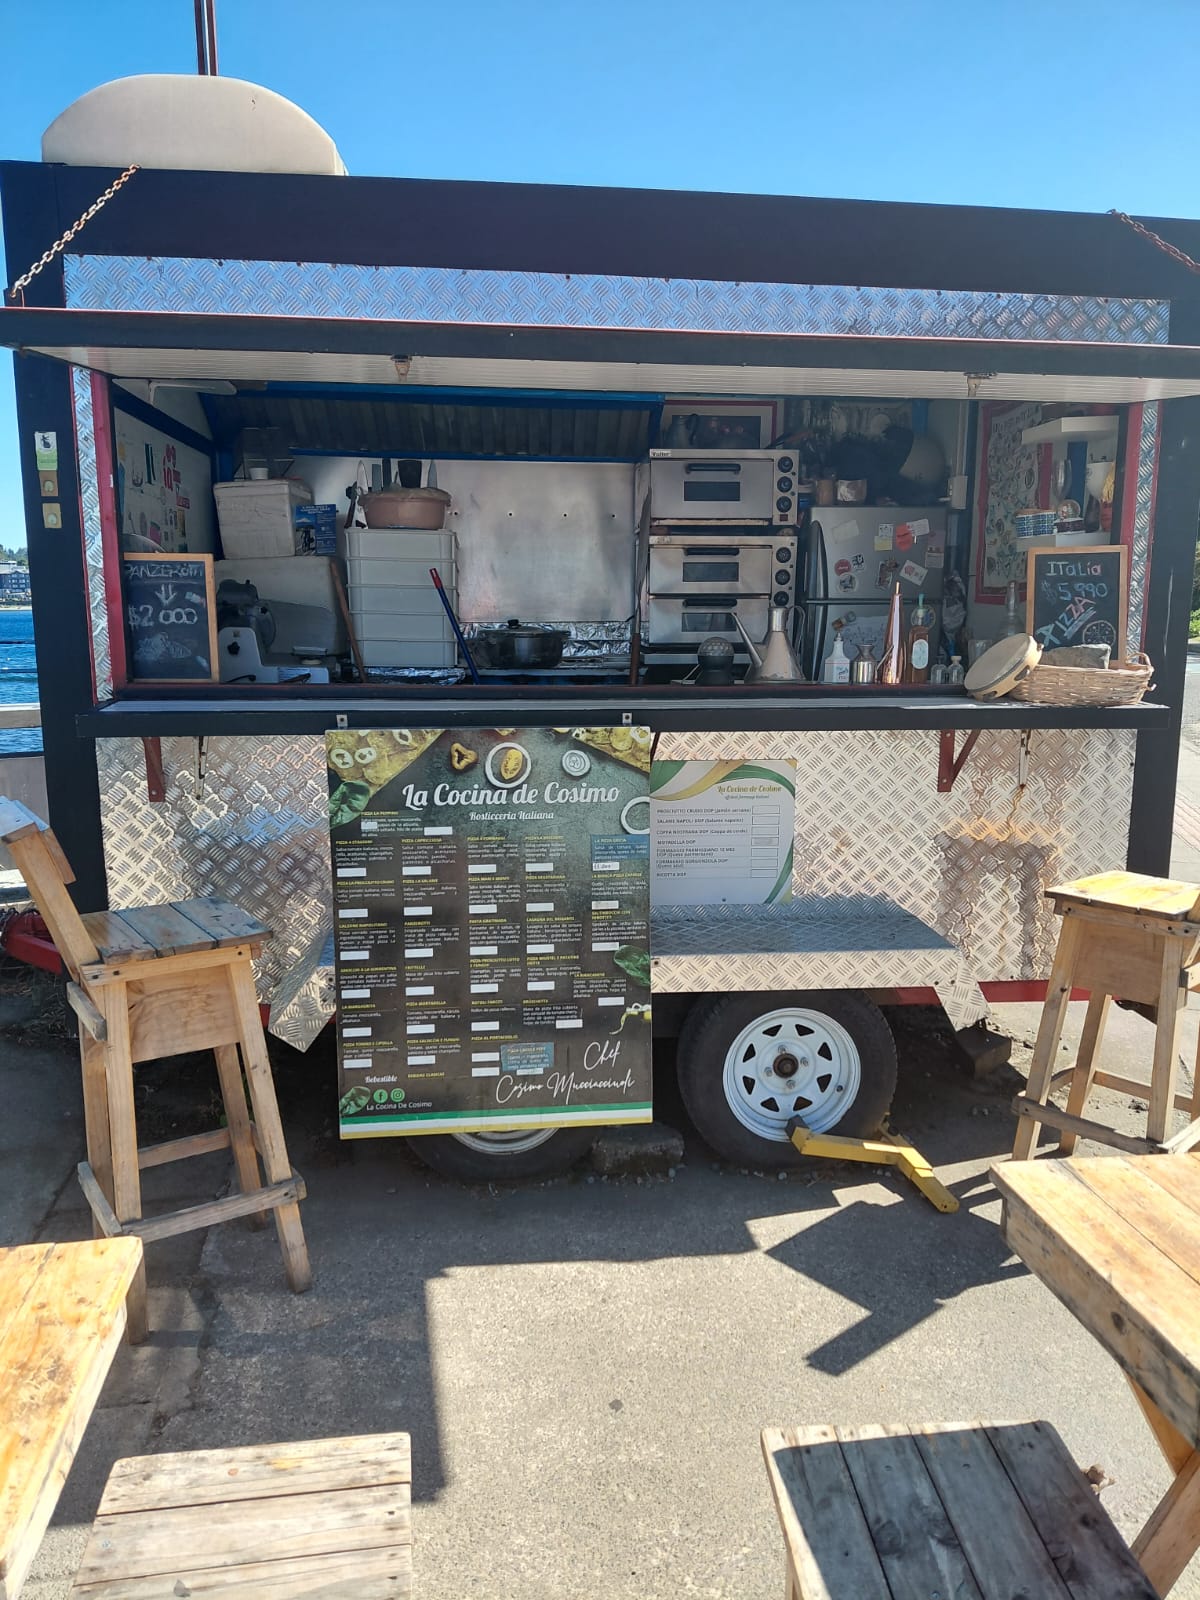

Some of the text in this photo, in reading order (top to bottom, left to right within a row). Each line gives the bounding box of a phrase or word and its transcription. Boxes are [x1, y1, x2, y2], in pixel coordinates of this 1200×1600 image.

[402, 781, 620, 811] La Cocina de Cosimo
[469, 810, 555, 821] Rosticceria Italiana
[583, 1039, 621, 1071] Chef
[496, 1074, 544, 1104] Cosimo
